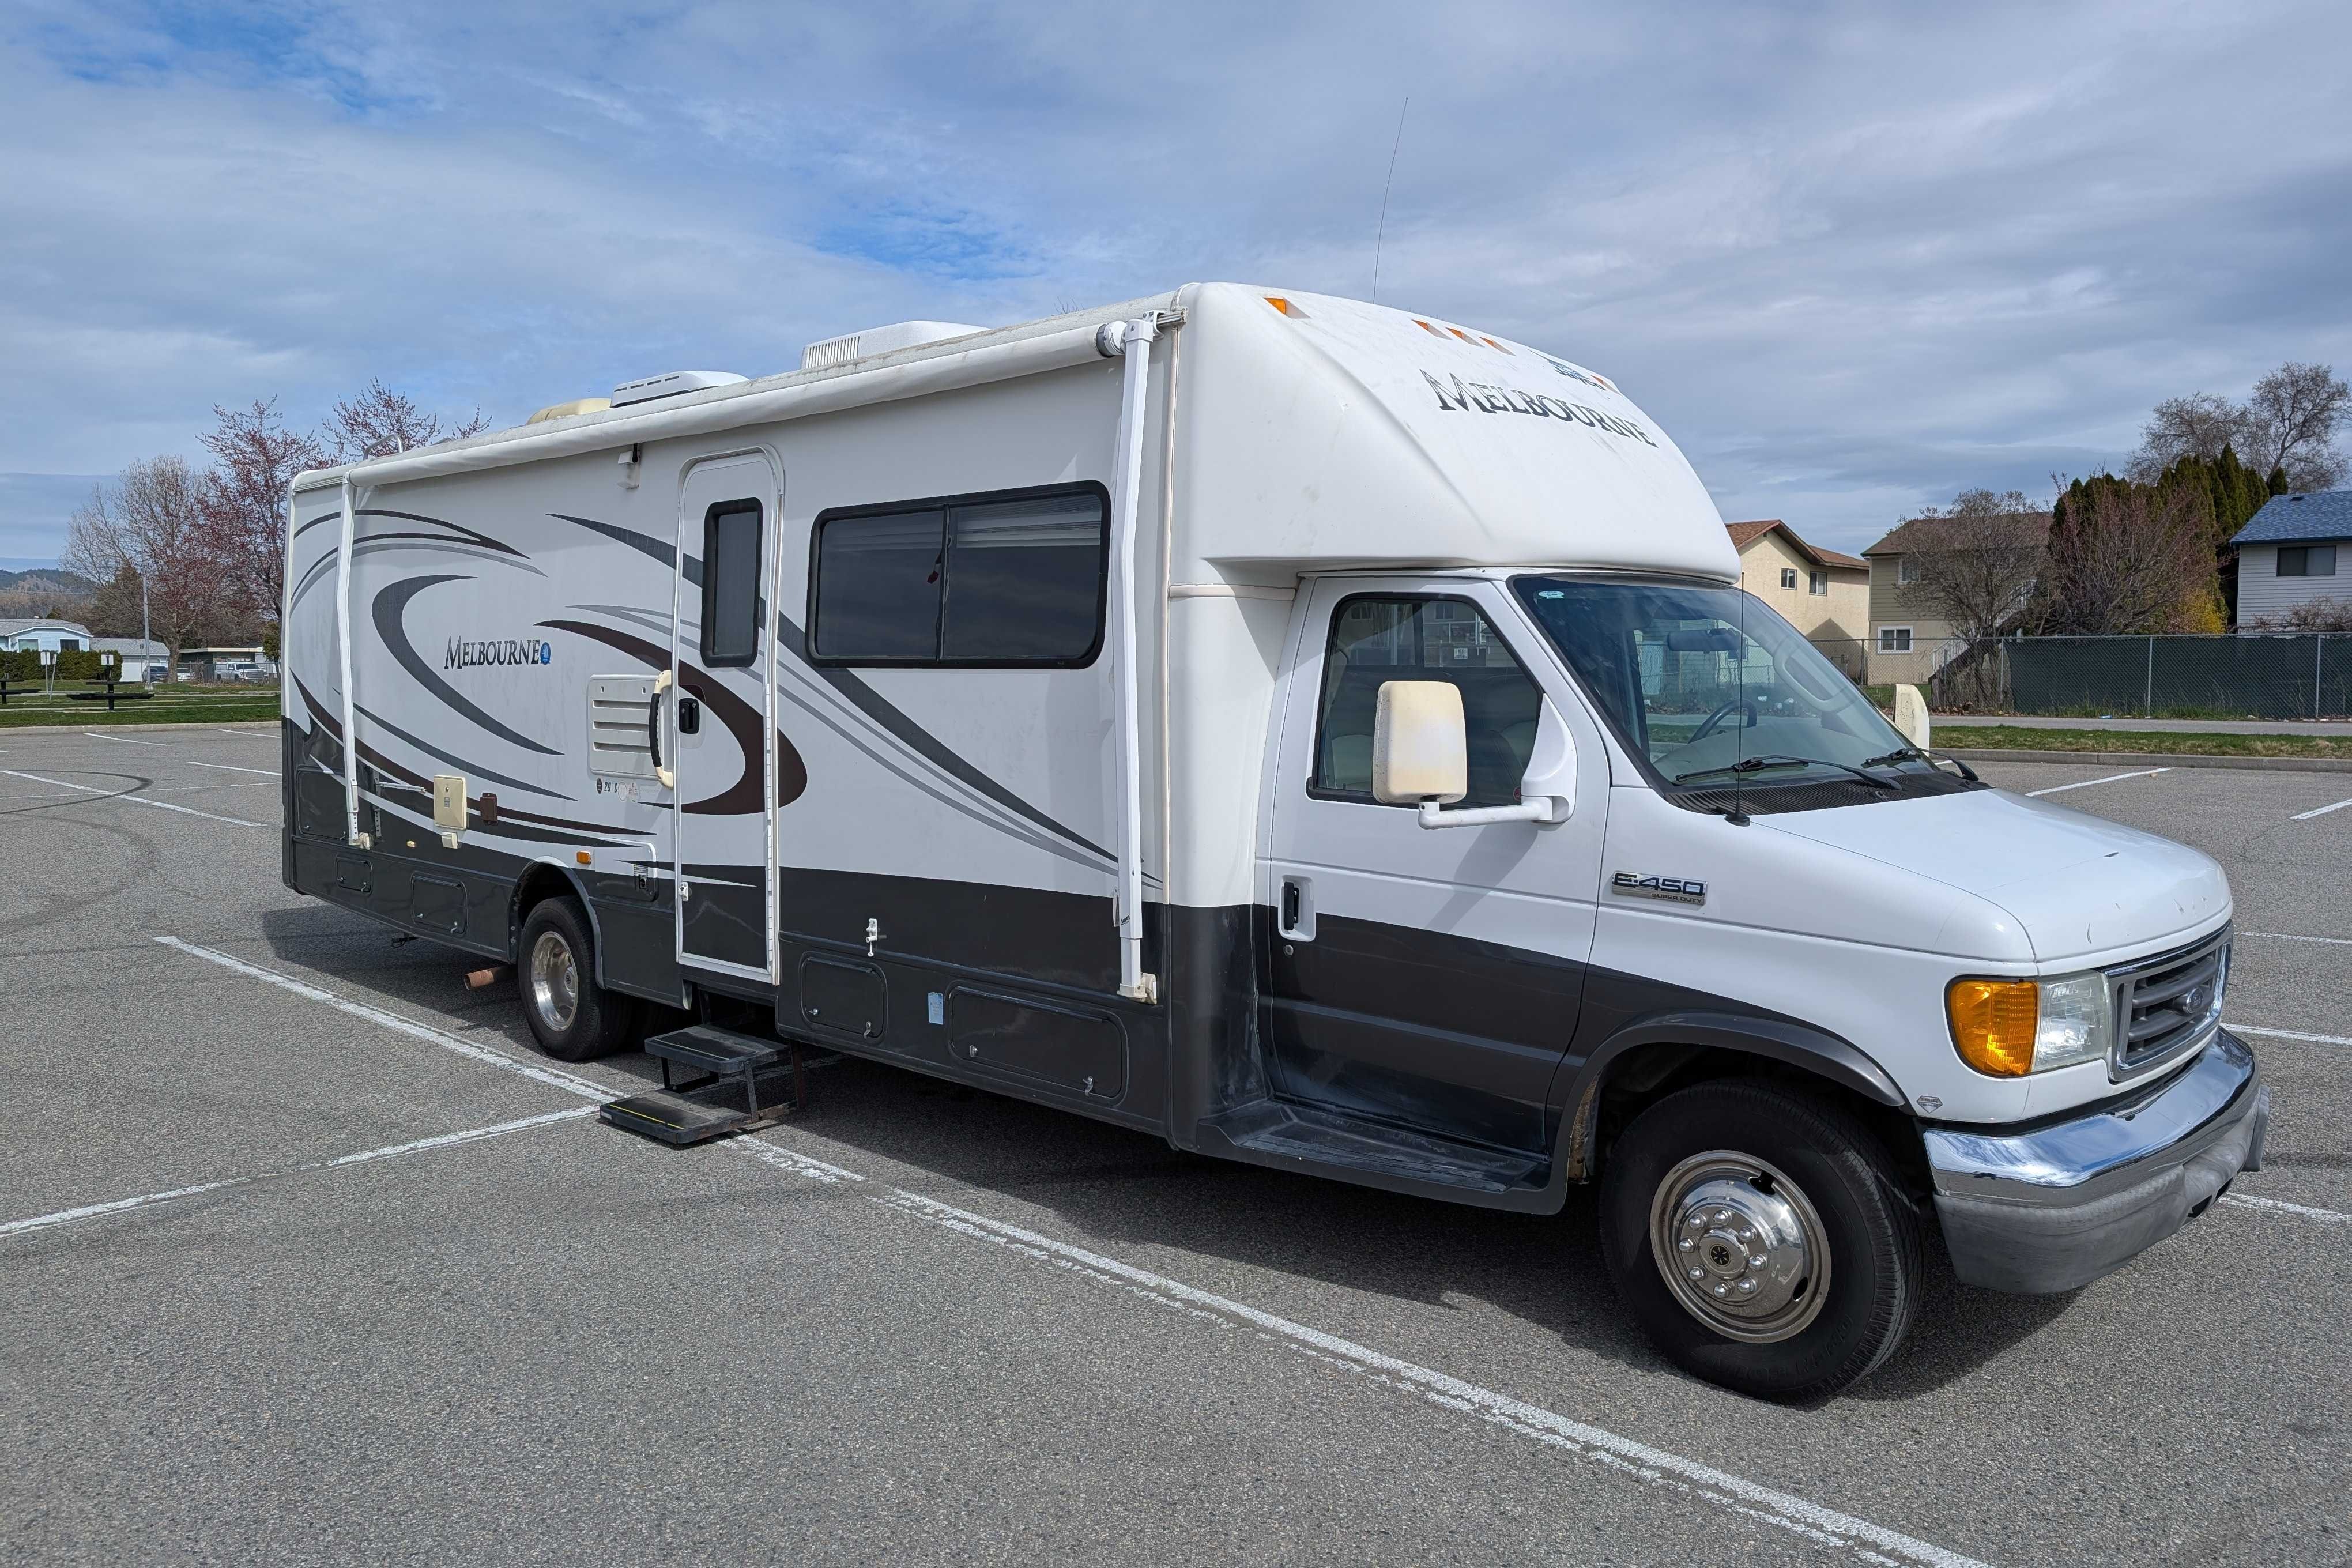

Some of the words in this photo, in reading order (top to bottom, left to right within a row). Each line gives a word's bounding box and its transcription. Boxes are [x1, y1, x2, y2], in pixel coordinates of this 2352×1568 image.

[1419, 368, 1659, 448] MELBOURNE
[443, 635, 540, 670] MELBOURNE
[604, 781, 611, 792] 29
[1652, 893, 1678, 901] SUPER
[1680, 895, 1702, 904] DUTY
